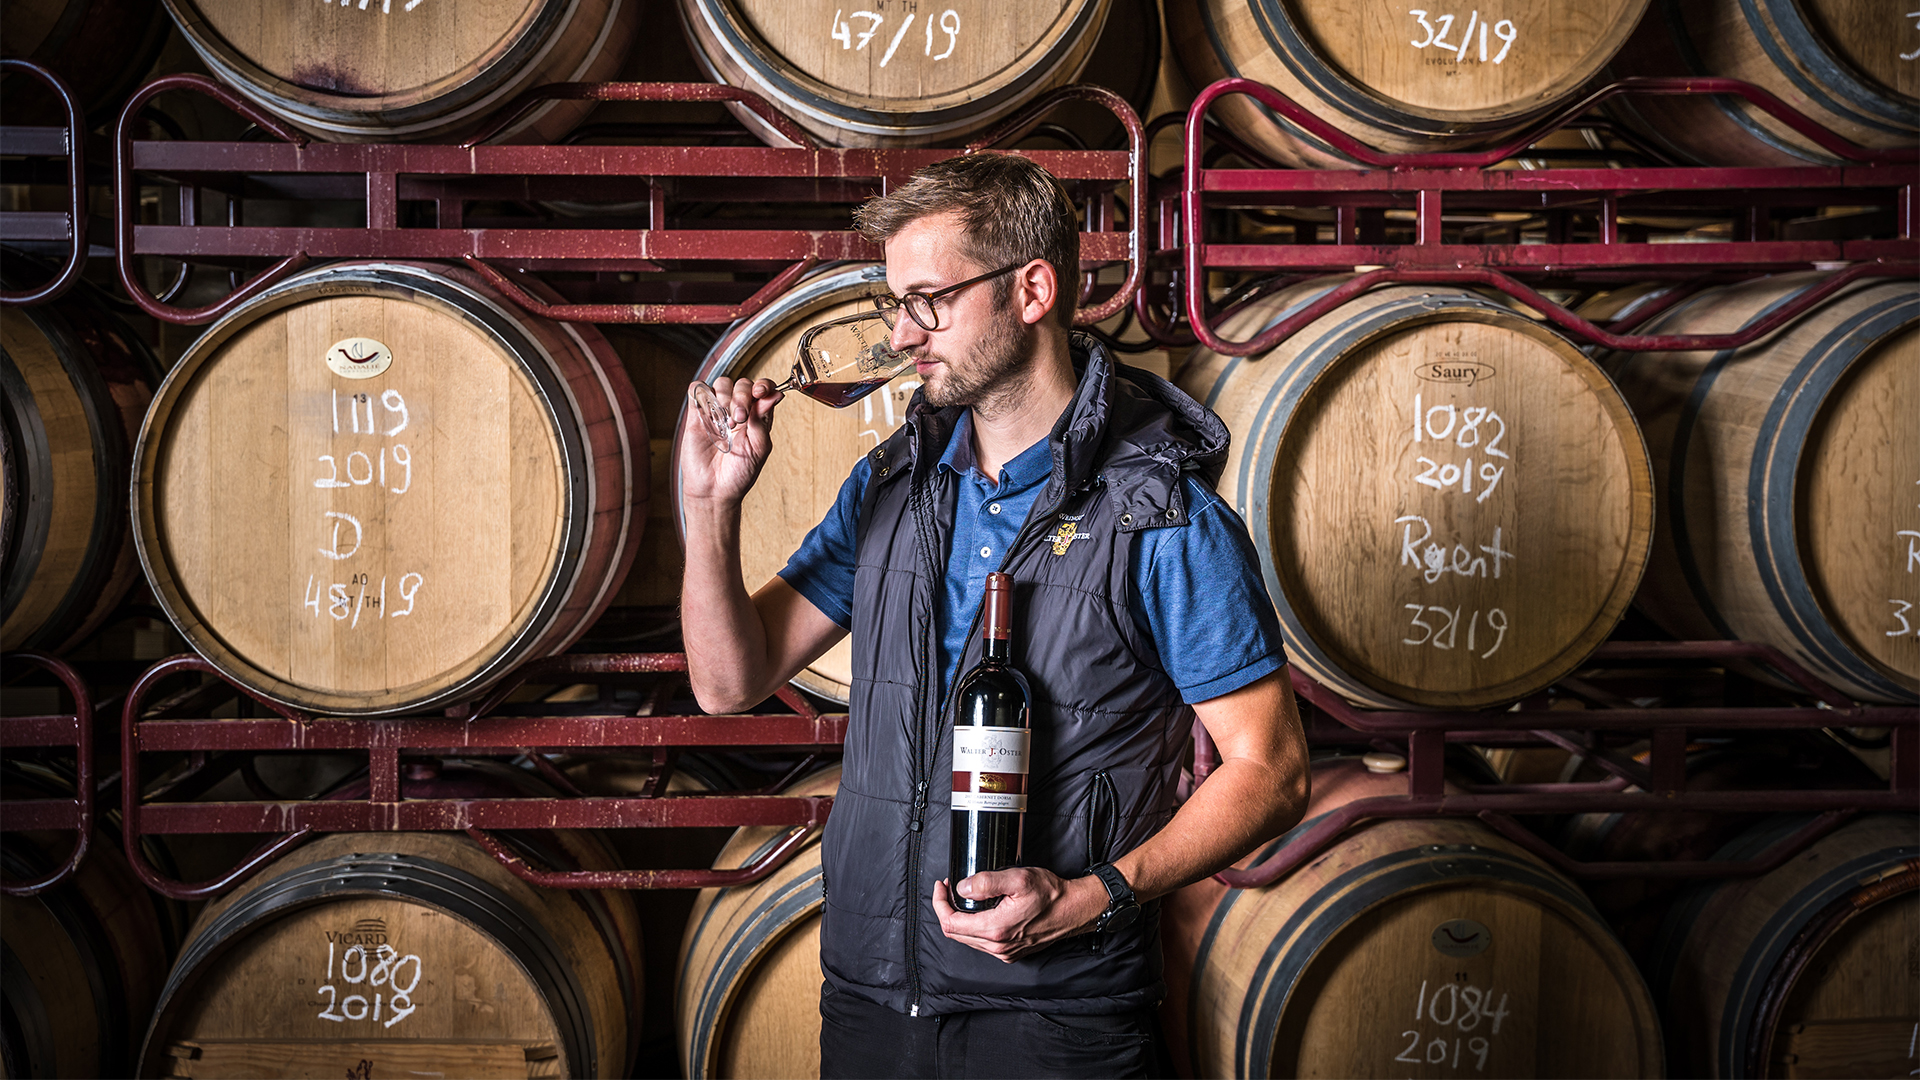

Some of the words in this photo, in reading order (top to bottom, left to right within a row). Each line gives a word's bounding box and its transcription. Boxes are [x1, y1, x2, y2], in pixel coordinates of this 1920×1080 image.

[832, 9, 960, 68] 47/19
[1409, 10, 1517, 64] 32/19
[892, 391, 904, 401] 13
[1431, 364, 1480, 387] Saury
[332, 388, 410, 437] 1119
[1414, 393, 1509, 459] 1082
[314, 444, 411, 494] 2019
[1415, 456, 1505, 503] 2019
[318, 511, 362, 560] D
[305, 572, 423, 630] 48/19
[365, 596, 380, 608] TH
[989, 748, 996, 757] J.
[1000, 748, 1022, 756] OSTER
[325, 931, 387, 945] VICARD
[327, 943, 421, 994] 1080
[318, 985, 416, 1028] 2019
[1416, 979, 1509, 1035] 1084
[1395, 1030, 1489, 1072] 2019
